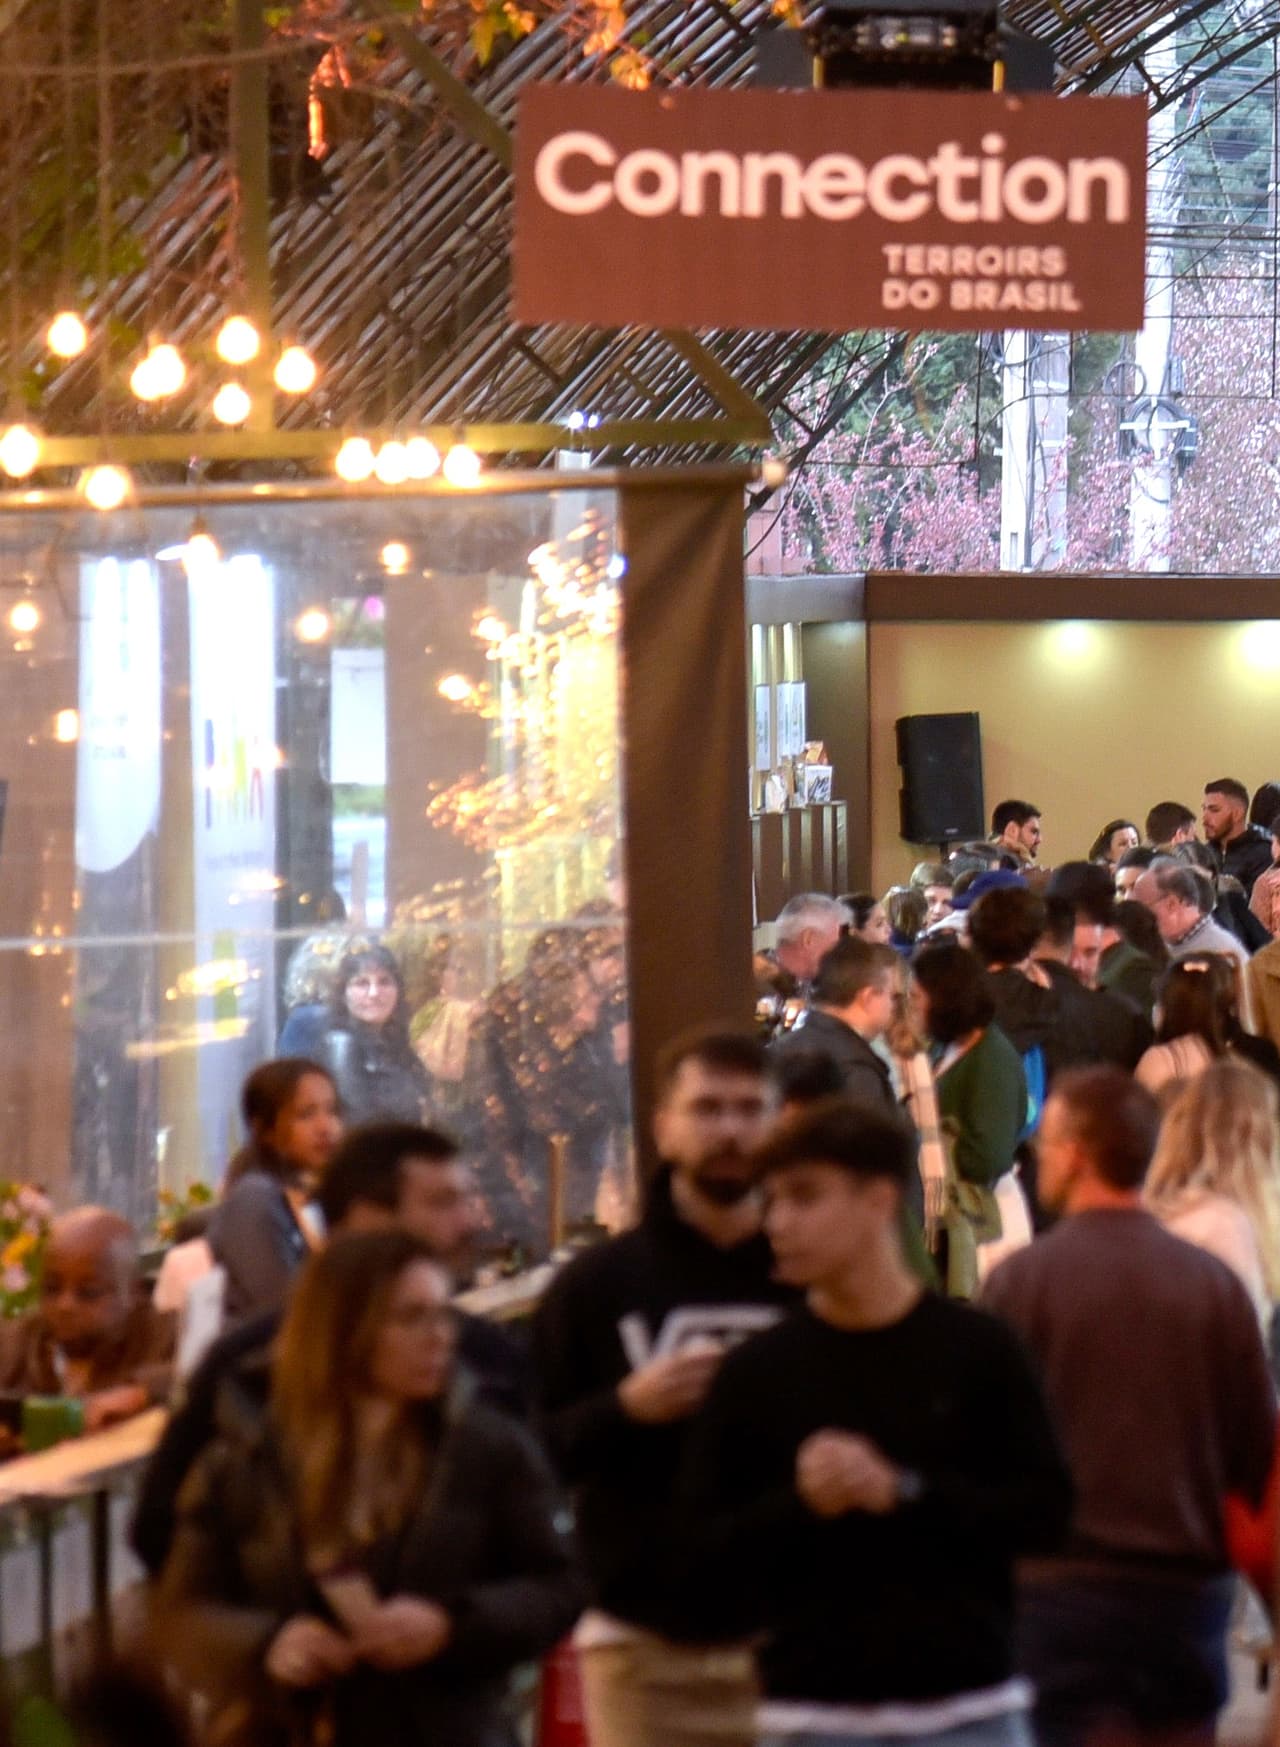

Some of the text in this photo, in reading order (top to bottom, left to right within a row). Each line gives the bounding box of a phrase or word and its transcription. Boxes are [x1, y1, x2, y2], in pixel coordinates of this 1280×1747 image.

[534, 130, 1131, 225] Connection
[883, 244, 1067, 278] TERROIRS
[882, 280, 1083, 313] DO BRASIL
